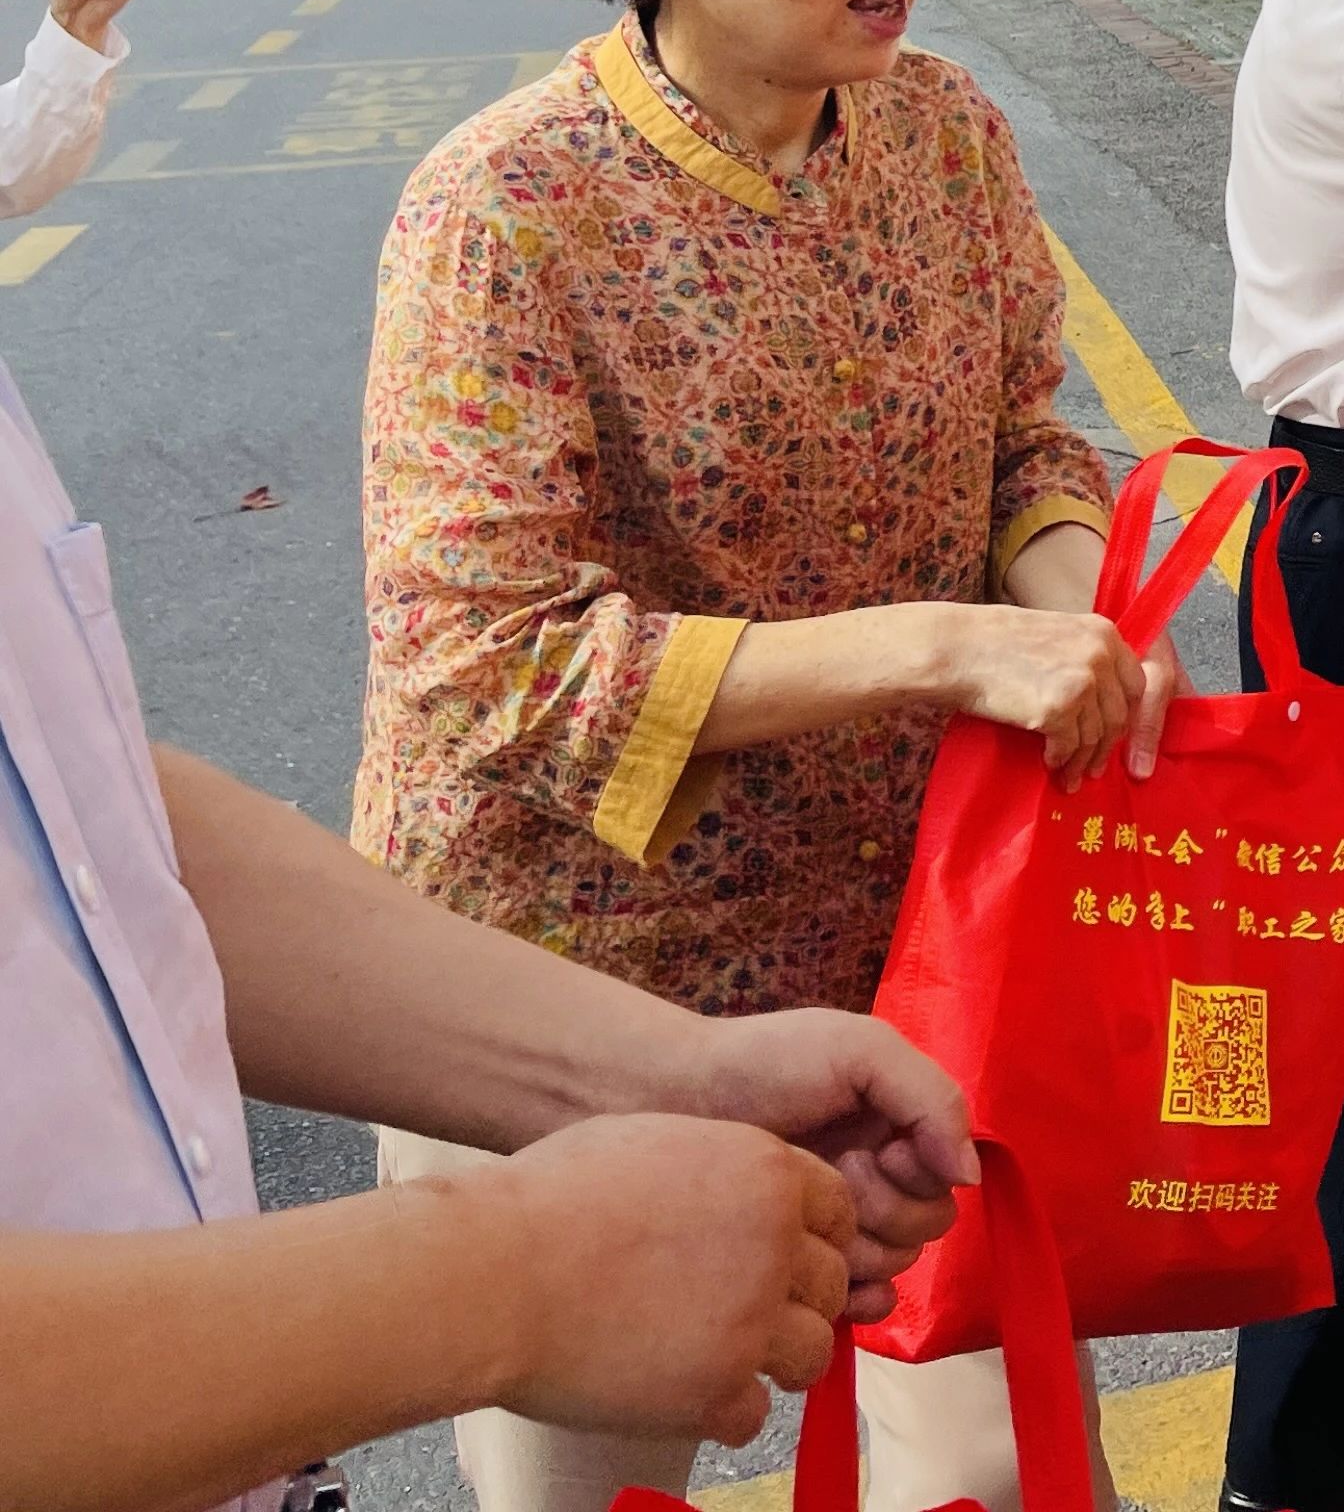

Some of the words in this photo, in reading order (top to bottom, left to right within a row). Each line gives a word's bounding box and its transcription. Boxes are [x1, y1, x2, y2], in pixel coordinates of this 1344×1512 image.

[1126, 1179, 1281, 1215] 欢迎扫码关注
